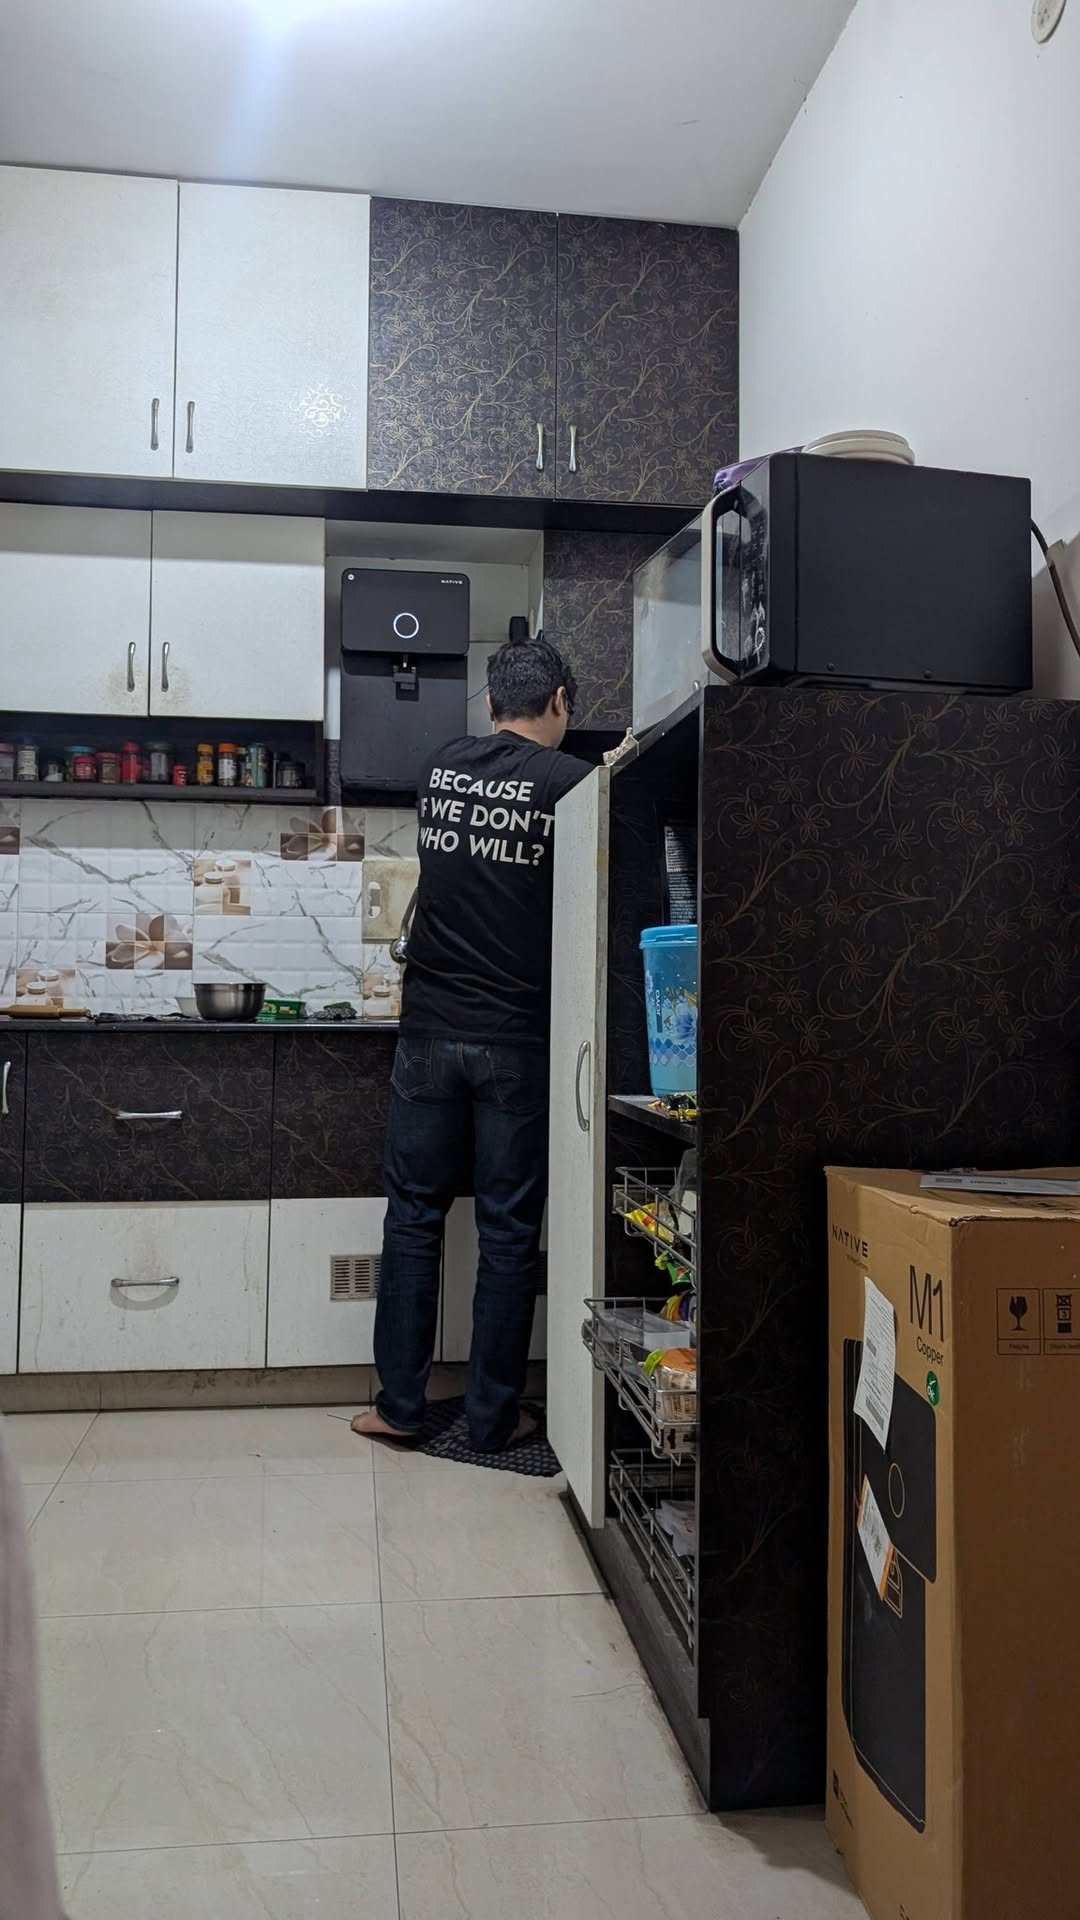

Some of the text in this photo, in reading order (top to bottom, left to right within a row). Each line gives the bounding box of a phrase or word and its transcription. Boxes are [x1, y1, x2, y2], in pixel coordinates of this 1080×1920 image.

[429, 768, 534, 802] BECAUSE
[431, 796, 465, 823] WE
[469, 804, 555, 837] DON'T
[469, 834, 545, 866] WILL?
[832, 1224, 869, 1258] NATIVE
[909, 1264, 944, 1344] M1
[916, 1336, 944, 1367] Copper
